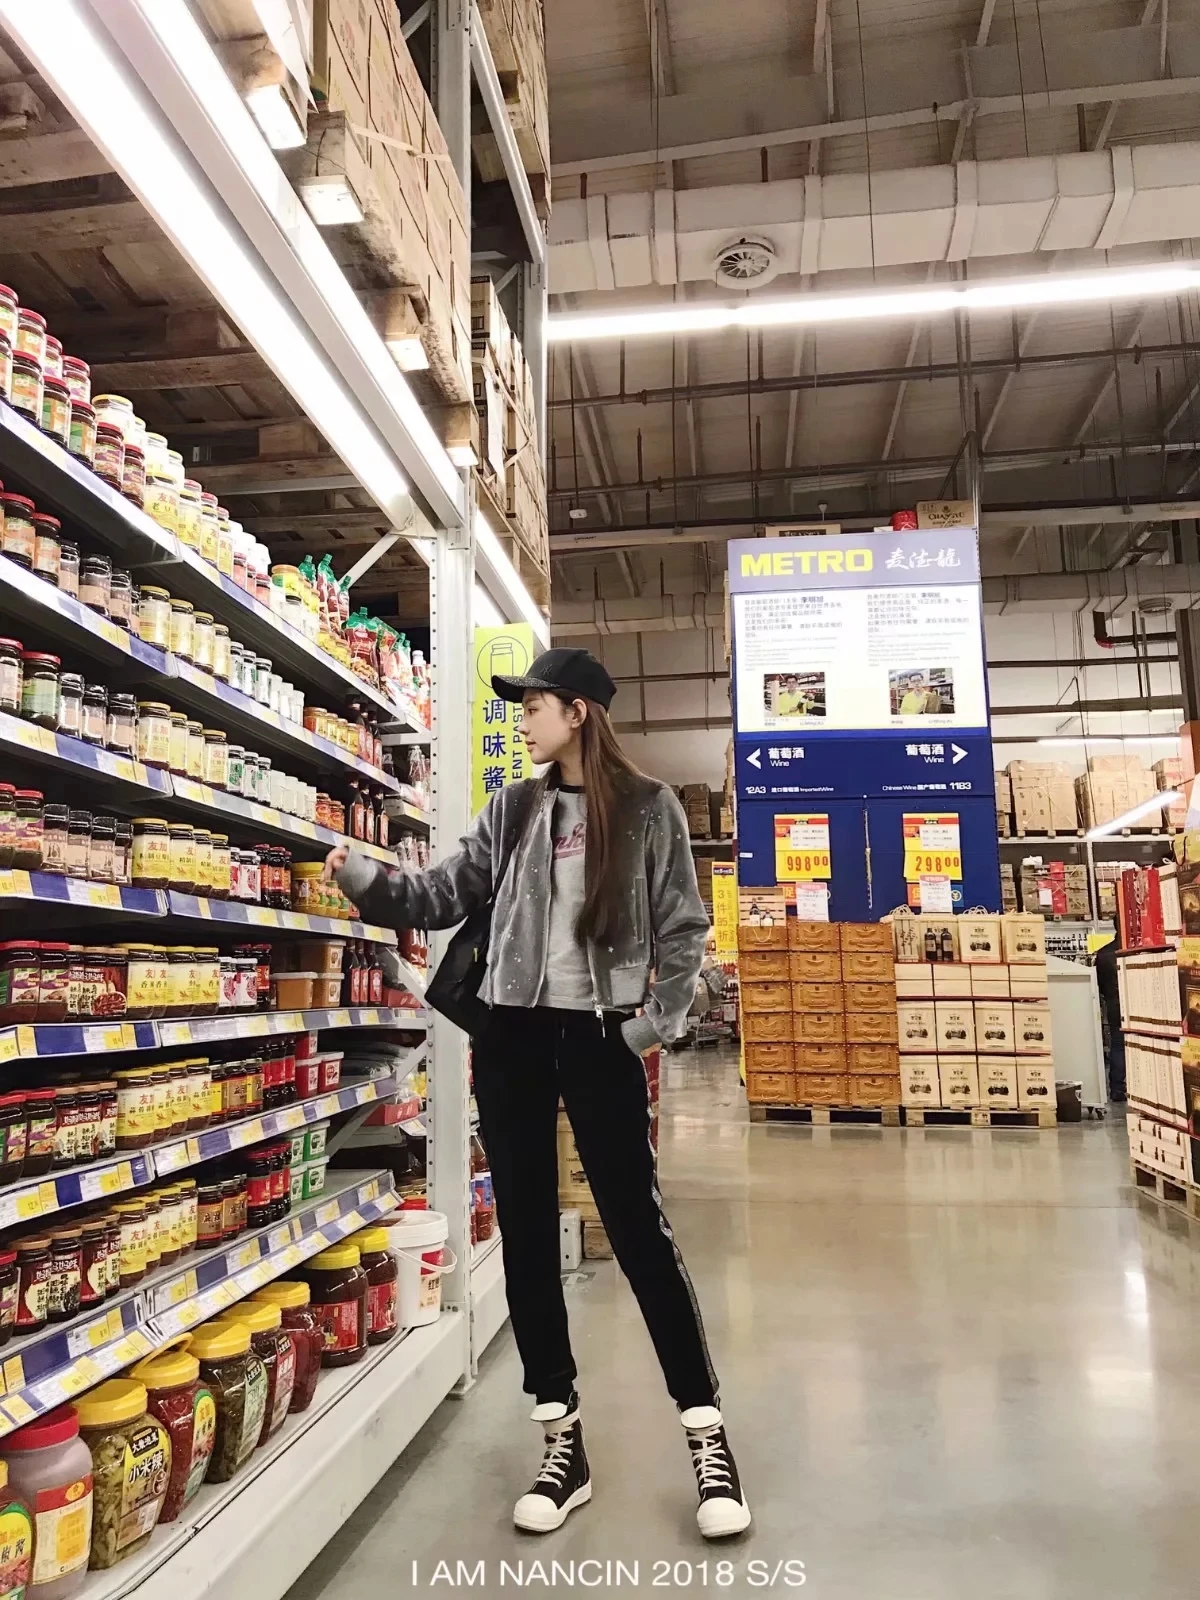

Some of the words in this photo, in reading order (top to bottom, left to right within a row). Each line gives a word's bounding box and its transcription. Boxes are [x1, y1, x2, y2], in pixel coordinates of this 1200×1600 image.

[740, 549, 873, 577] METRO
[512, 702, 523, 743] PAST
[482, 699, 507, 794] 调味酱
[767, 747, 805, 759] 葡萄酒
[905, 744, 944, 756] 葡萄酒
[512, 750, 523, 779] ENT
[745, 786, 766, 794] 12A3
[129, 1449, 164, 1484] 小米辣
